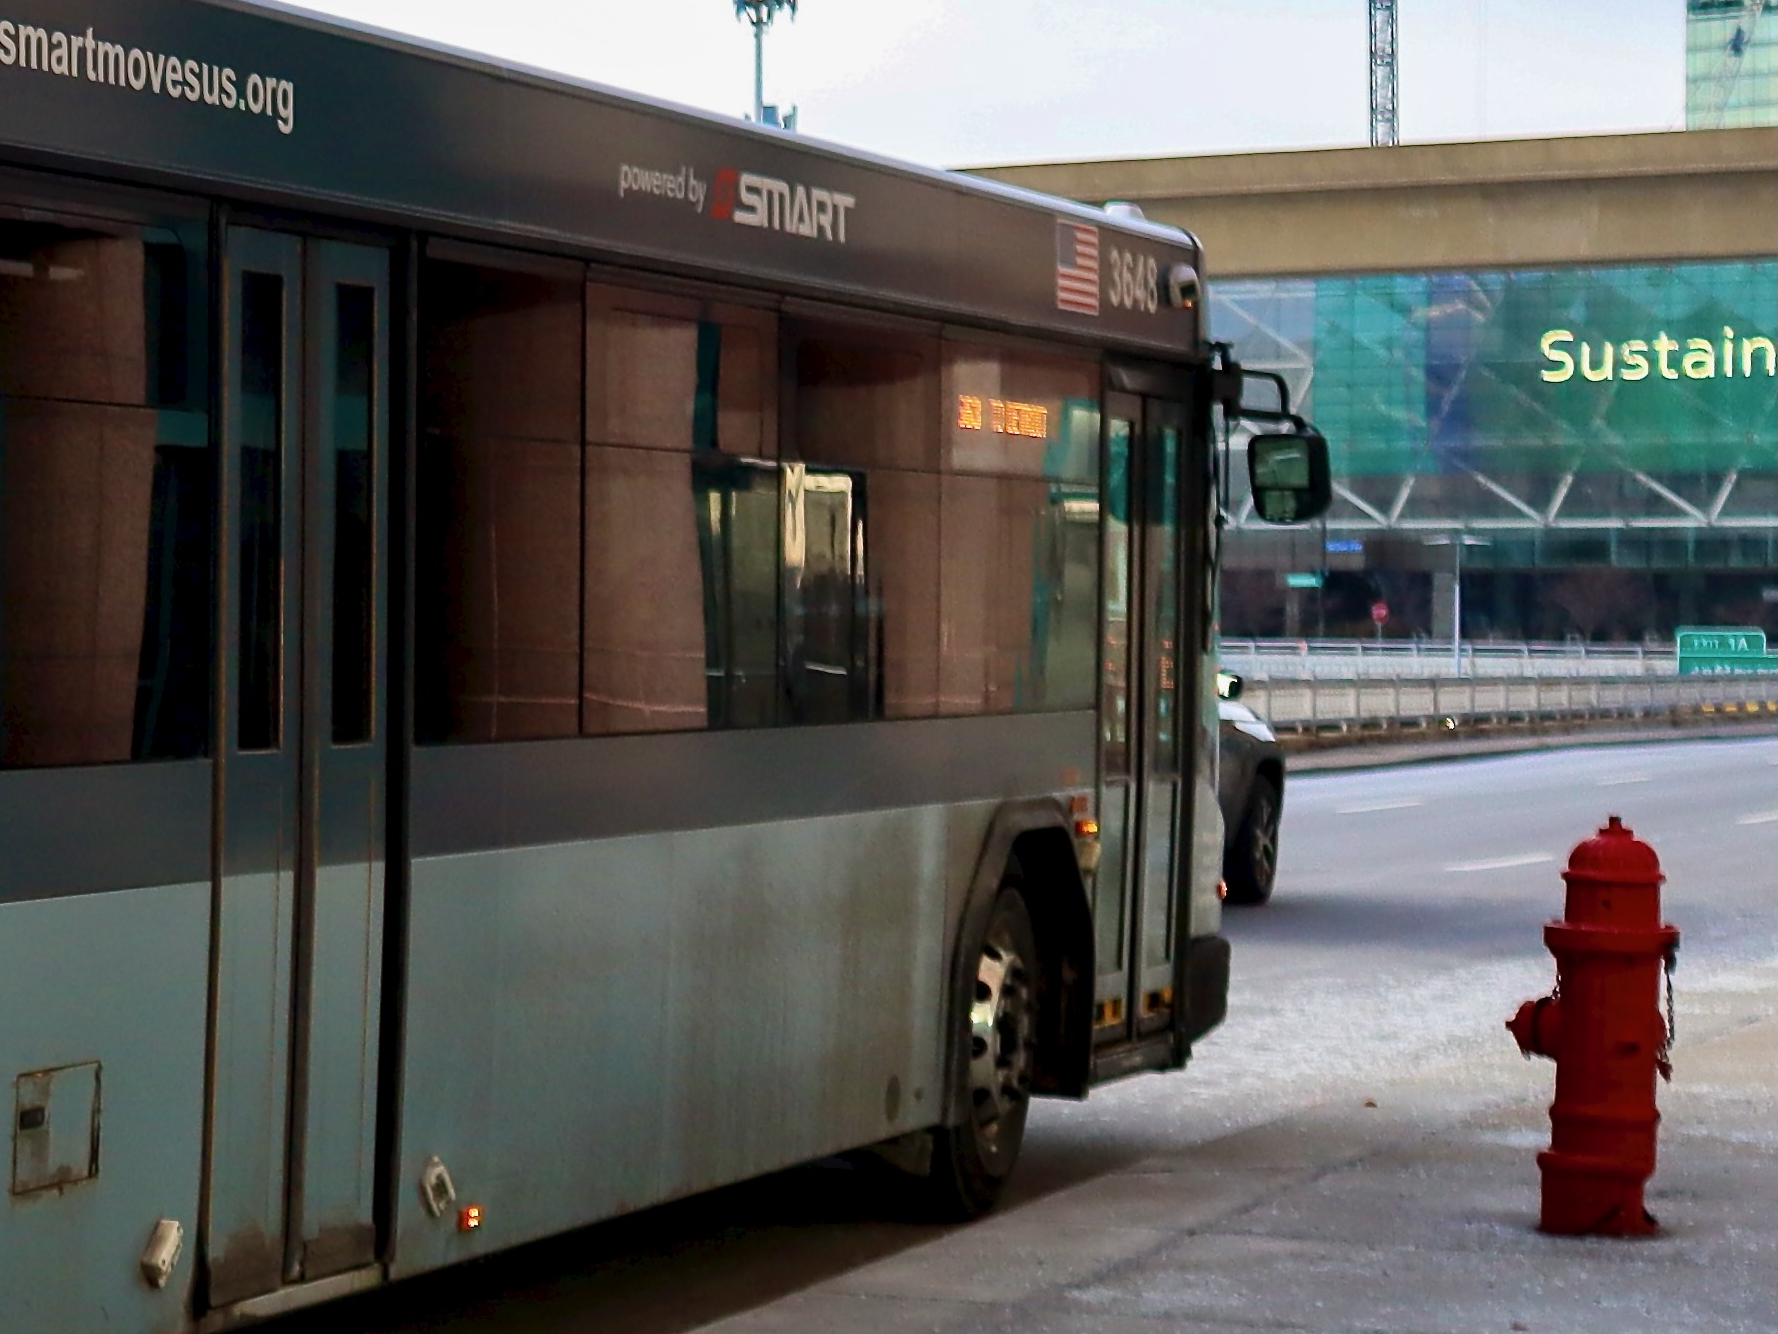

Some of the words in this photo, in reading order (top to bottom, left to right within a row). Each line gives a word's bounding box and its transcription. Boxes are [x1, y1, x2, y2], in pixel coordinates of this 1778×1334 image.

[618, 163, 687, 201] powered
[688, 175, 708, 213] by
[732, 171, 856, 243] SMART
[1106, 249, 1159, 315] 3648
[1540, 325, 1777, 383] Sustain
